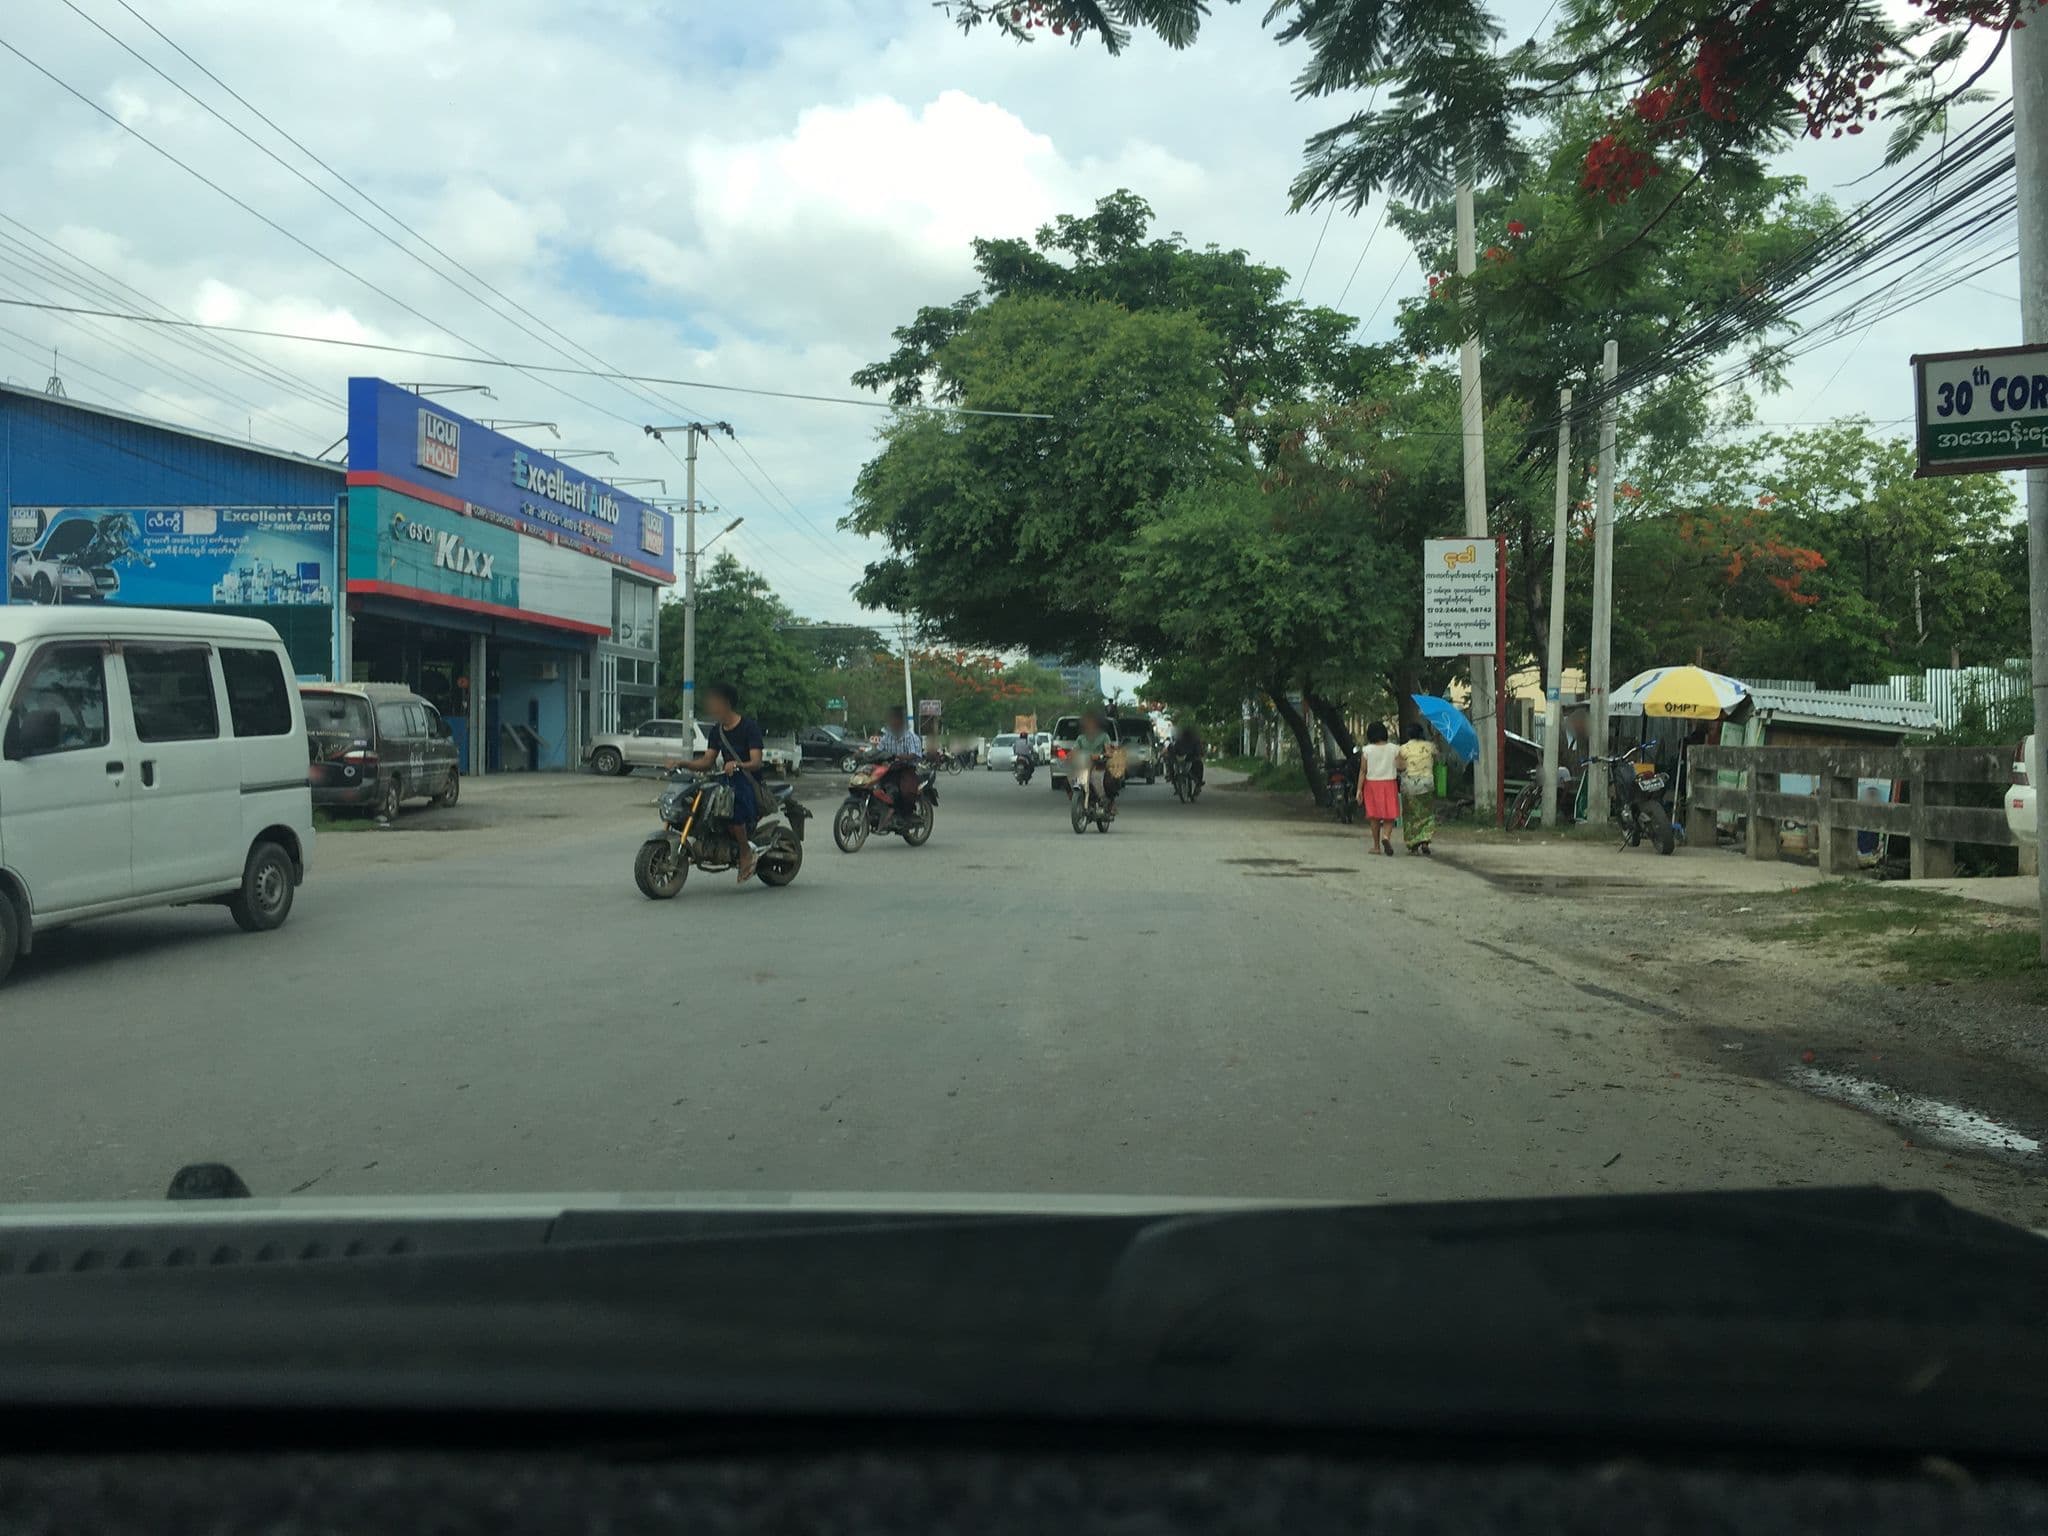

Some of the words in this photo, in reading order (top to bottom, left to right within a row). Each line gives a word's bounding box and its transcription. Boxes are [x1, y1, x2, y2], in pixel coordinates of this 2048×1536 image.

[426, 414, 458, 447] LIQUI
[425, 440, 458, 472] MOLY
[512, 449, 587, 511] Excellent
[589, 483, 620, 526] Auto
[223, 510, 293, 523] Excellent
[297, 510, 331, 523] Auto
